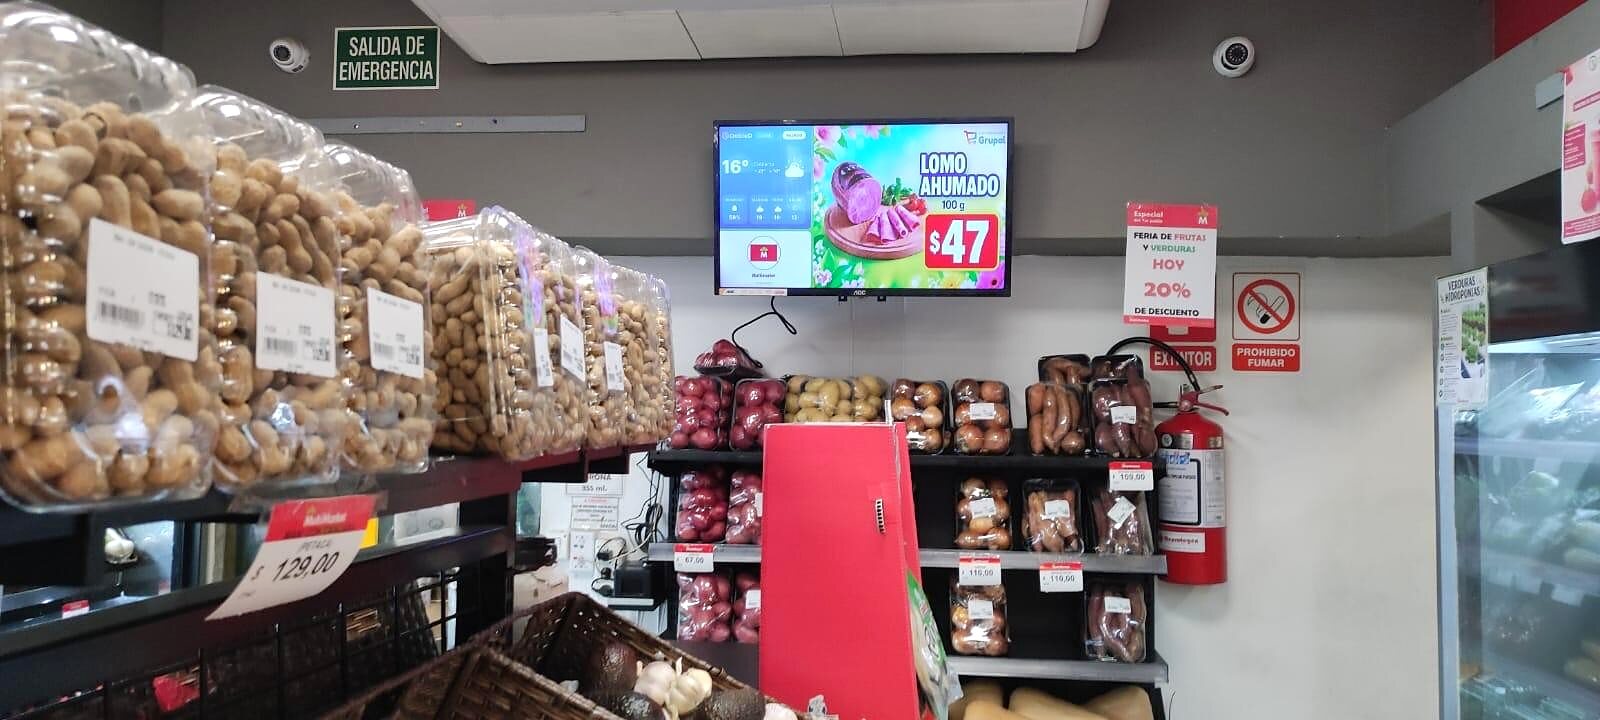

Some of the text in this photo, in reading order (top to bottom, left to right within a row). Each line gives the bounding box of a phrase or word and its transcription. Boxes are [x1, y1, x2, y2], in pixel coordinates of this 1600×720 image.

[349, 36, 425, 56] SALIDA DE
[340, 60, 434, 80] EMERGENCIA
[978, 135, 1006, 146] Grupal
[920, 152, 967, 174] LOMO
[920, 174, 1000, 197] AHUMADO
[942, 200, 965, 211] 100 g
[1133, 210, 1164, 218] Especial
[1198, 216, 1208, 224] M
[1133, 232, 1158, 240] FERIA
[1151, 245, 1196, 253] VERDURAS
[1152, 259, 1184, 270] HOY
[1448, 277, 1475, 291] VERDURAS
[1144, 282, 1190, 298] 20%
[1149, 308, 1199, 316] DESCUENTO
[1237, 348, 1295, 357] PROHIBIDO
[1154, 351, 1212, 366] EXTNTOR
[1248, 359, 1284, 367] FUMAR
[272, 552, 340, 582] 129,00
